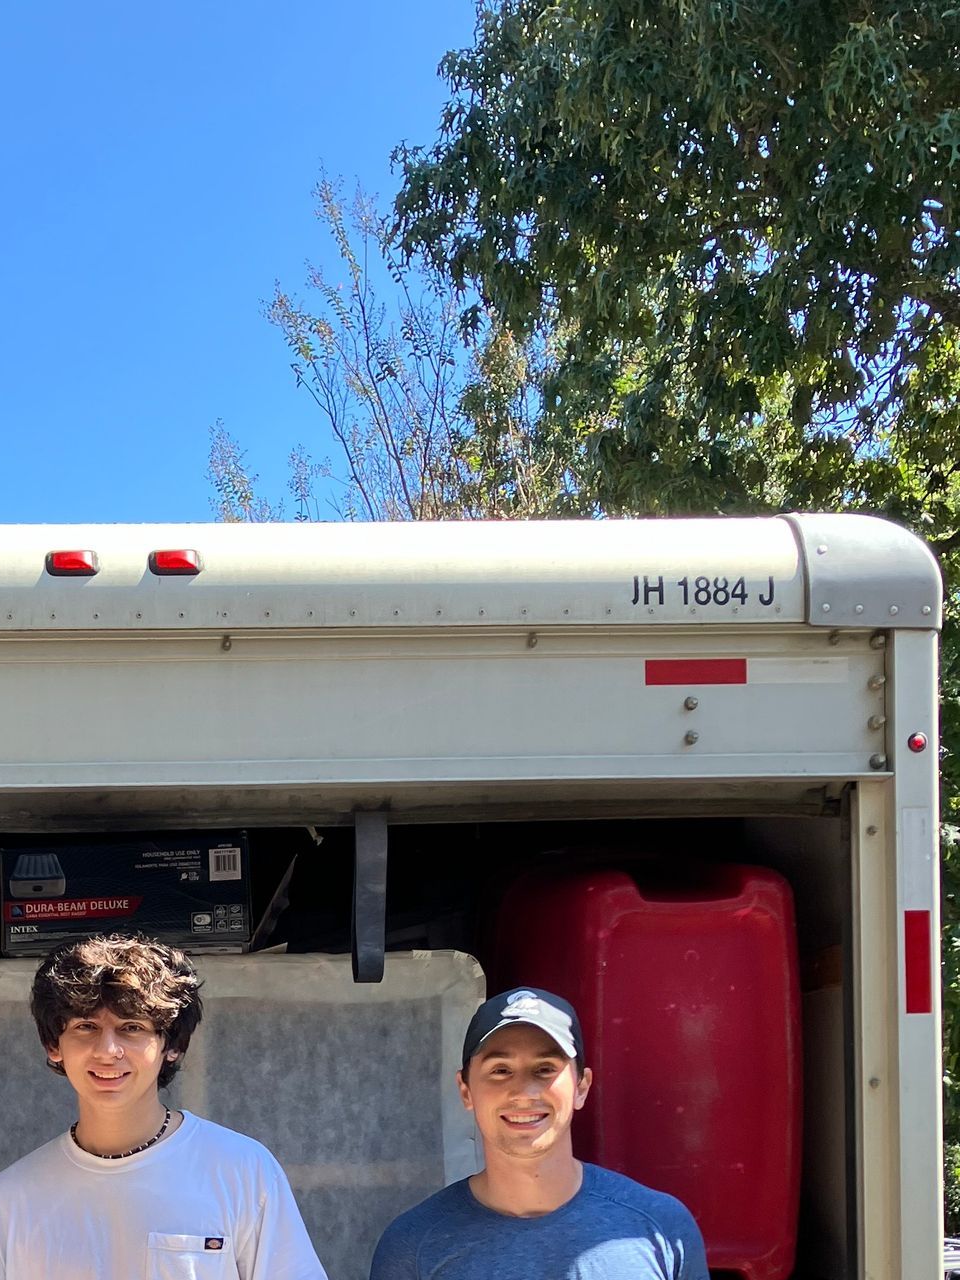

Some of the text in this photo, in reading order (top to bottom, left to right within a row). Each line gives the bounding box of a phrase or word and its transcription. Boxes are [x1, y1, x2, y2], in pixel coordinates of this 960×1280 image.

[631, 575, 775, 606] JH 1884 J
[25, 899, 129, 914] DURA-BEAM DELUXE
[10, 925, 39, 934] INTEX
